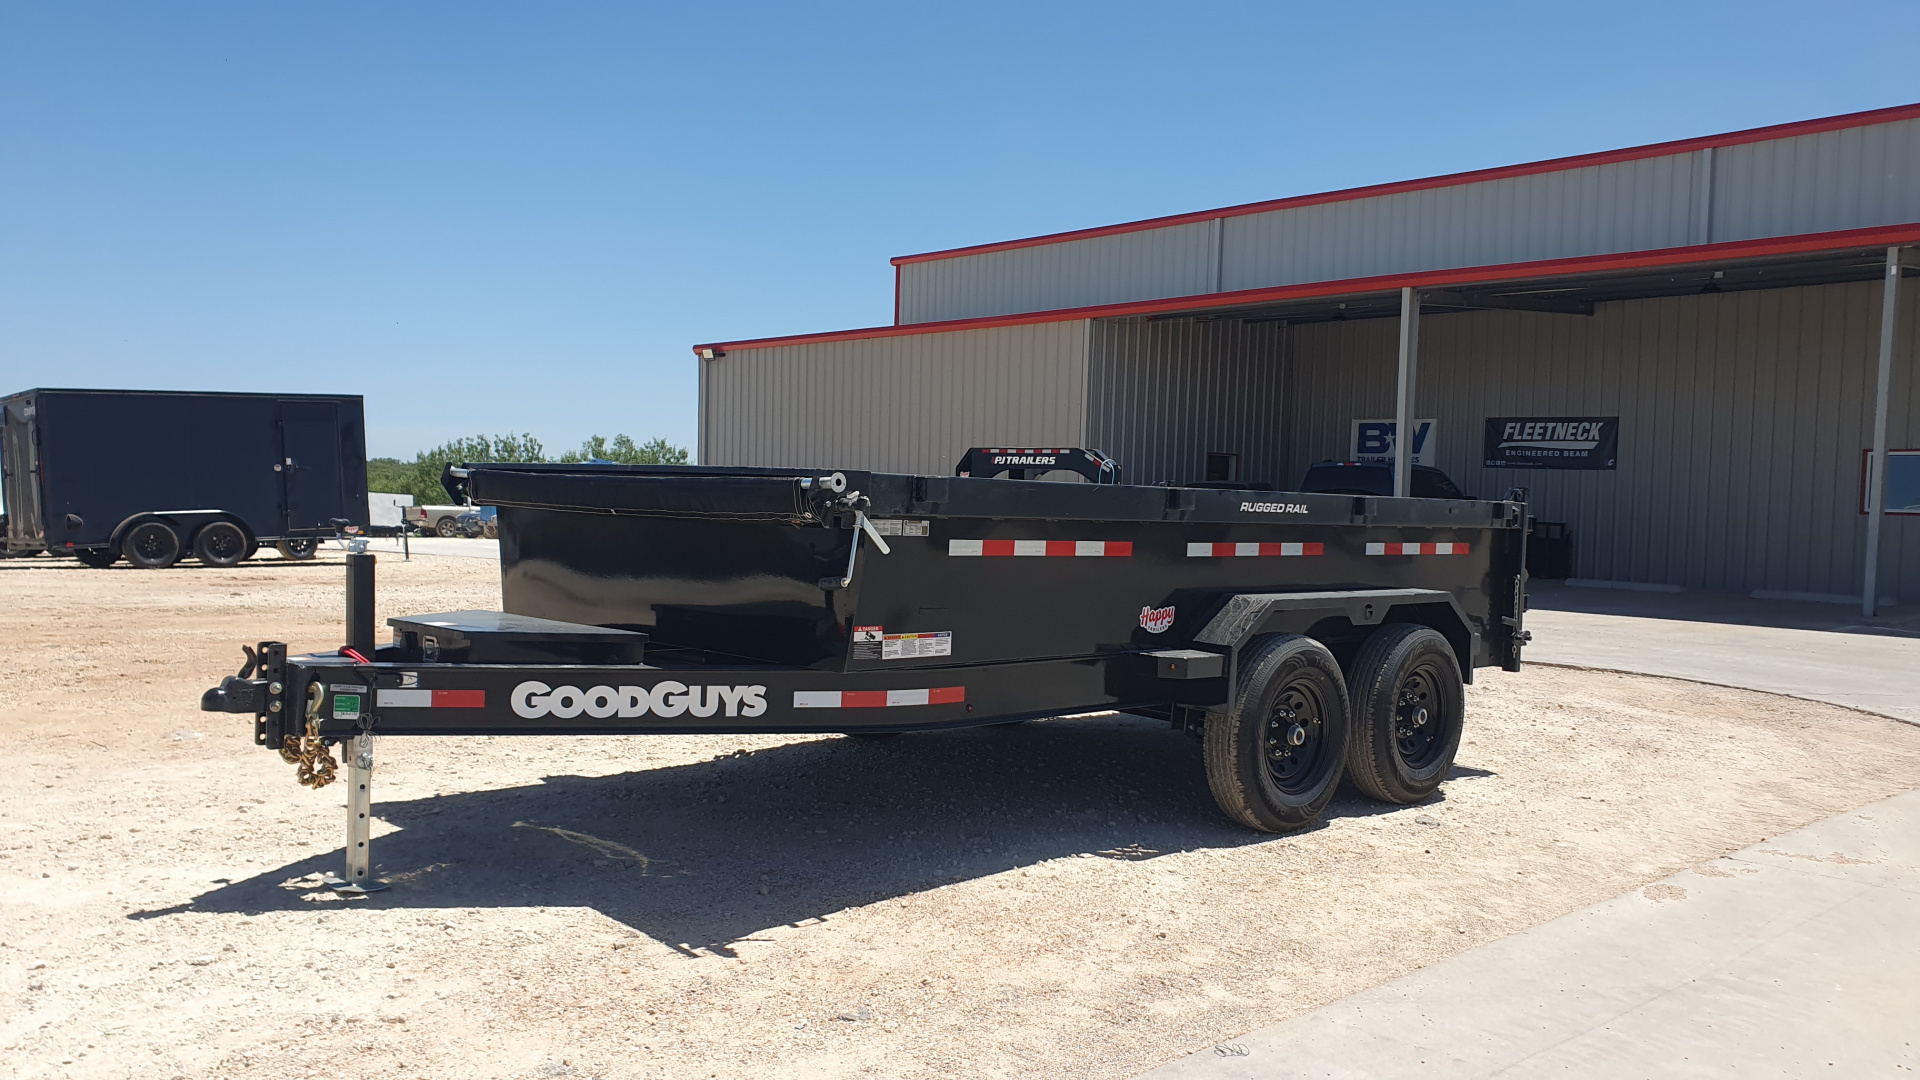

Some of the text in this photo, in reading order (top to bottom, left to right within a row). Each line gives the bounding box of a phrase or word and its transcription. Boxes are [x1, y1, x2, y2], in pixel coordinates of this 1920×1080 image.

[1502, 422, 1604, 440] FLEETNECK
[994, 456, 1056, 465] PJ TRAILERS
[1240, 502, 1309, 514] RUGGED RAIL
[1140, 606, 1175, 627] Happy
[510, 680, 768, 719] GOODGUYS
